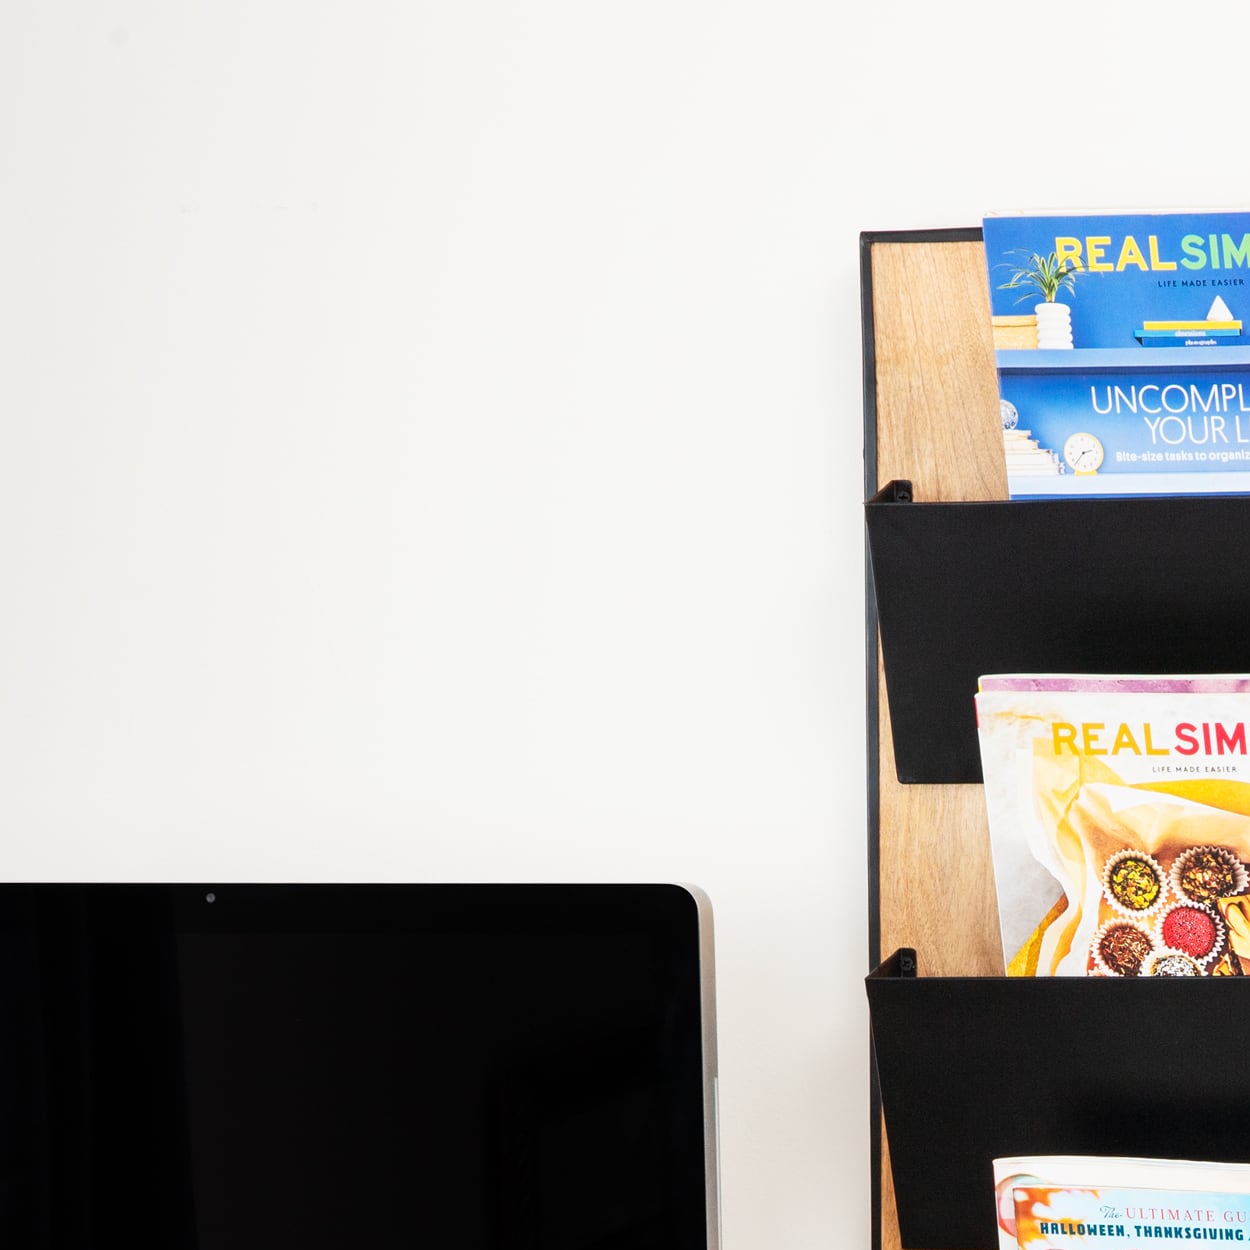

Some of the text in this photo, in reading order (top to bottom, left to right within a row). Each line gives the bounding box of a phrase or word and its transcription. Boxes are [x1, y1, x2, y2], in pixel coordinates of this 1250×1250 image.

[1181, 279, 1207, 287] MADE
[1211, 278, 1245, 286] EASIER
[1144, 415, 1229, 445] YOUR
[1116, 450, 1163, 462] Bite-size
[1165, 450, 1193, 461] tasks
[1195, 450, 1207, 461] to
[1099, 1205, 1123, 1219] The
[1125, 1207, 1216, 1222] ULTIMATE
[1040, 1222, 1131, 1239] HALLOWEEN,
[1134, 1225, 1244, 1242] THANKSGIVING
